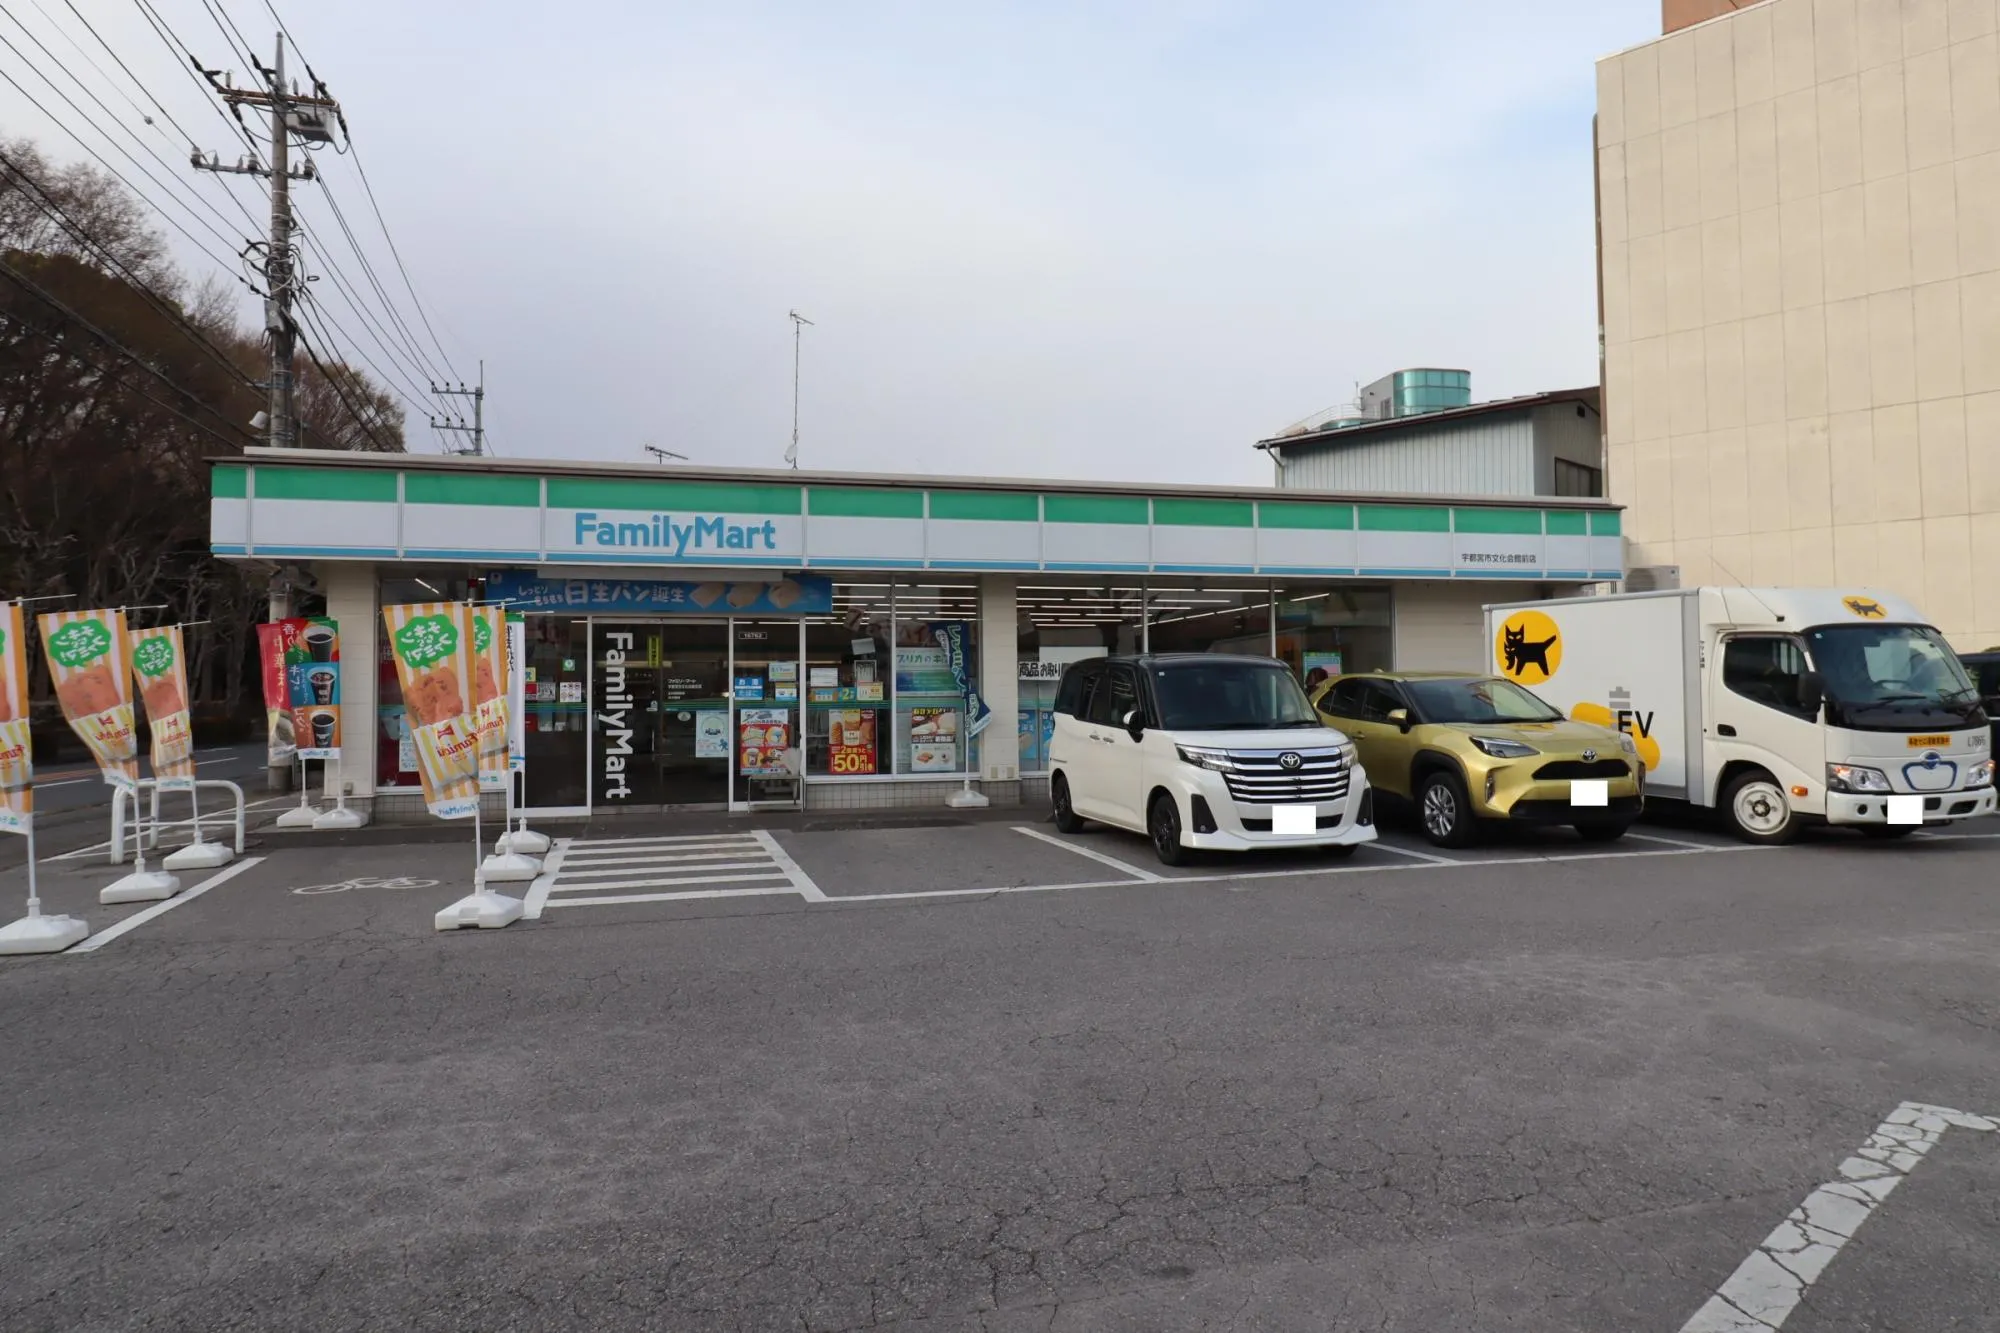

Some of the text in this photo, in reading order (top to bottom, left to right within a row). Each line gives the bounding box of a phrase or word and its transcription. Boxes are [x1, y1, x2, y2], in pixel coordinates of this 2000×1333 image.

[575, 512, 776, 557] FamilyMart
[1461, 553, 1536, 564] 宇都宮市文化会館前店
[518, 585, 548, 596] しっとり
[597, 631, 634, 799] FamilyMart
[1617, 710, 1654, 739] EV
